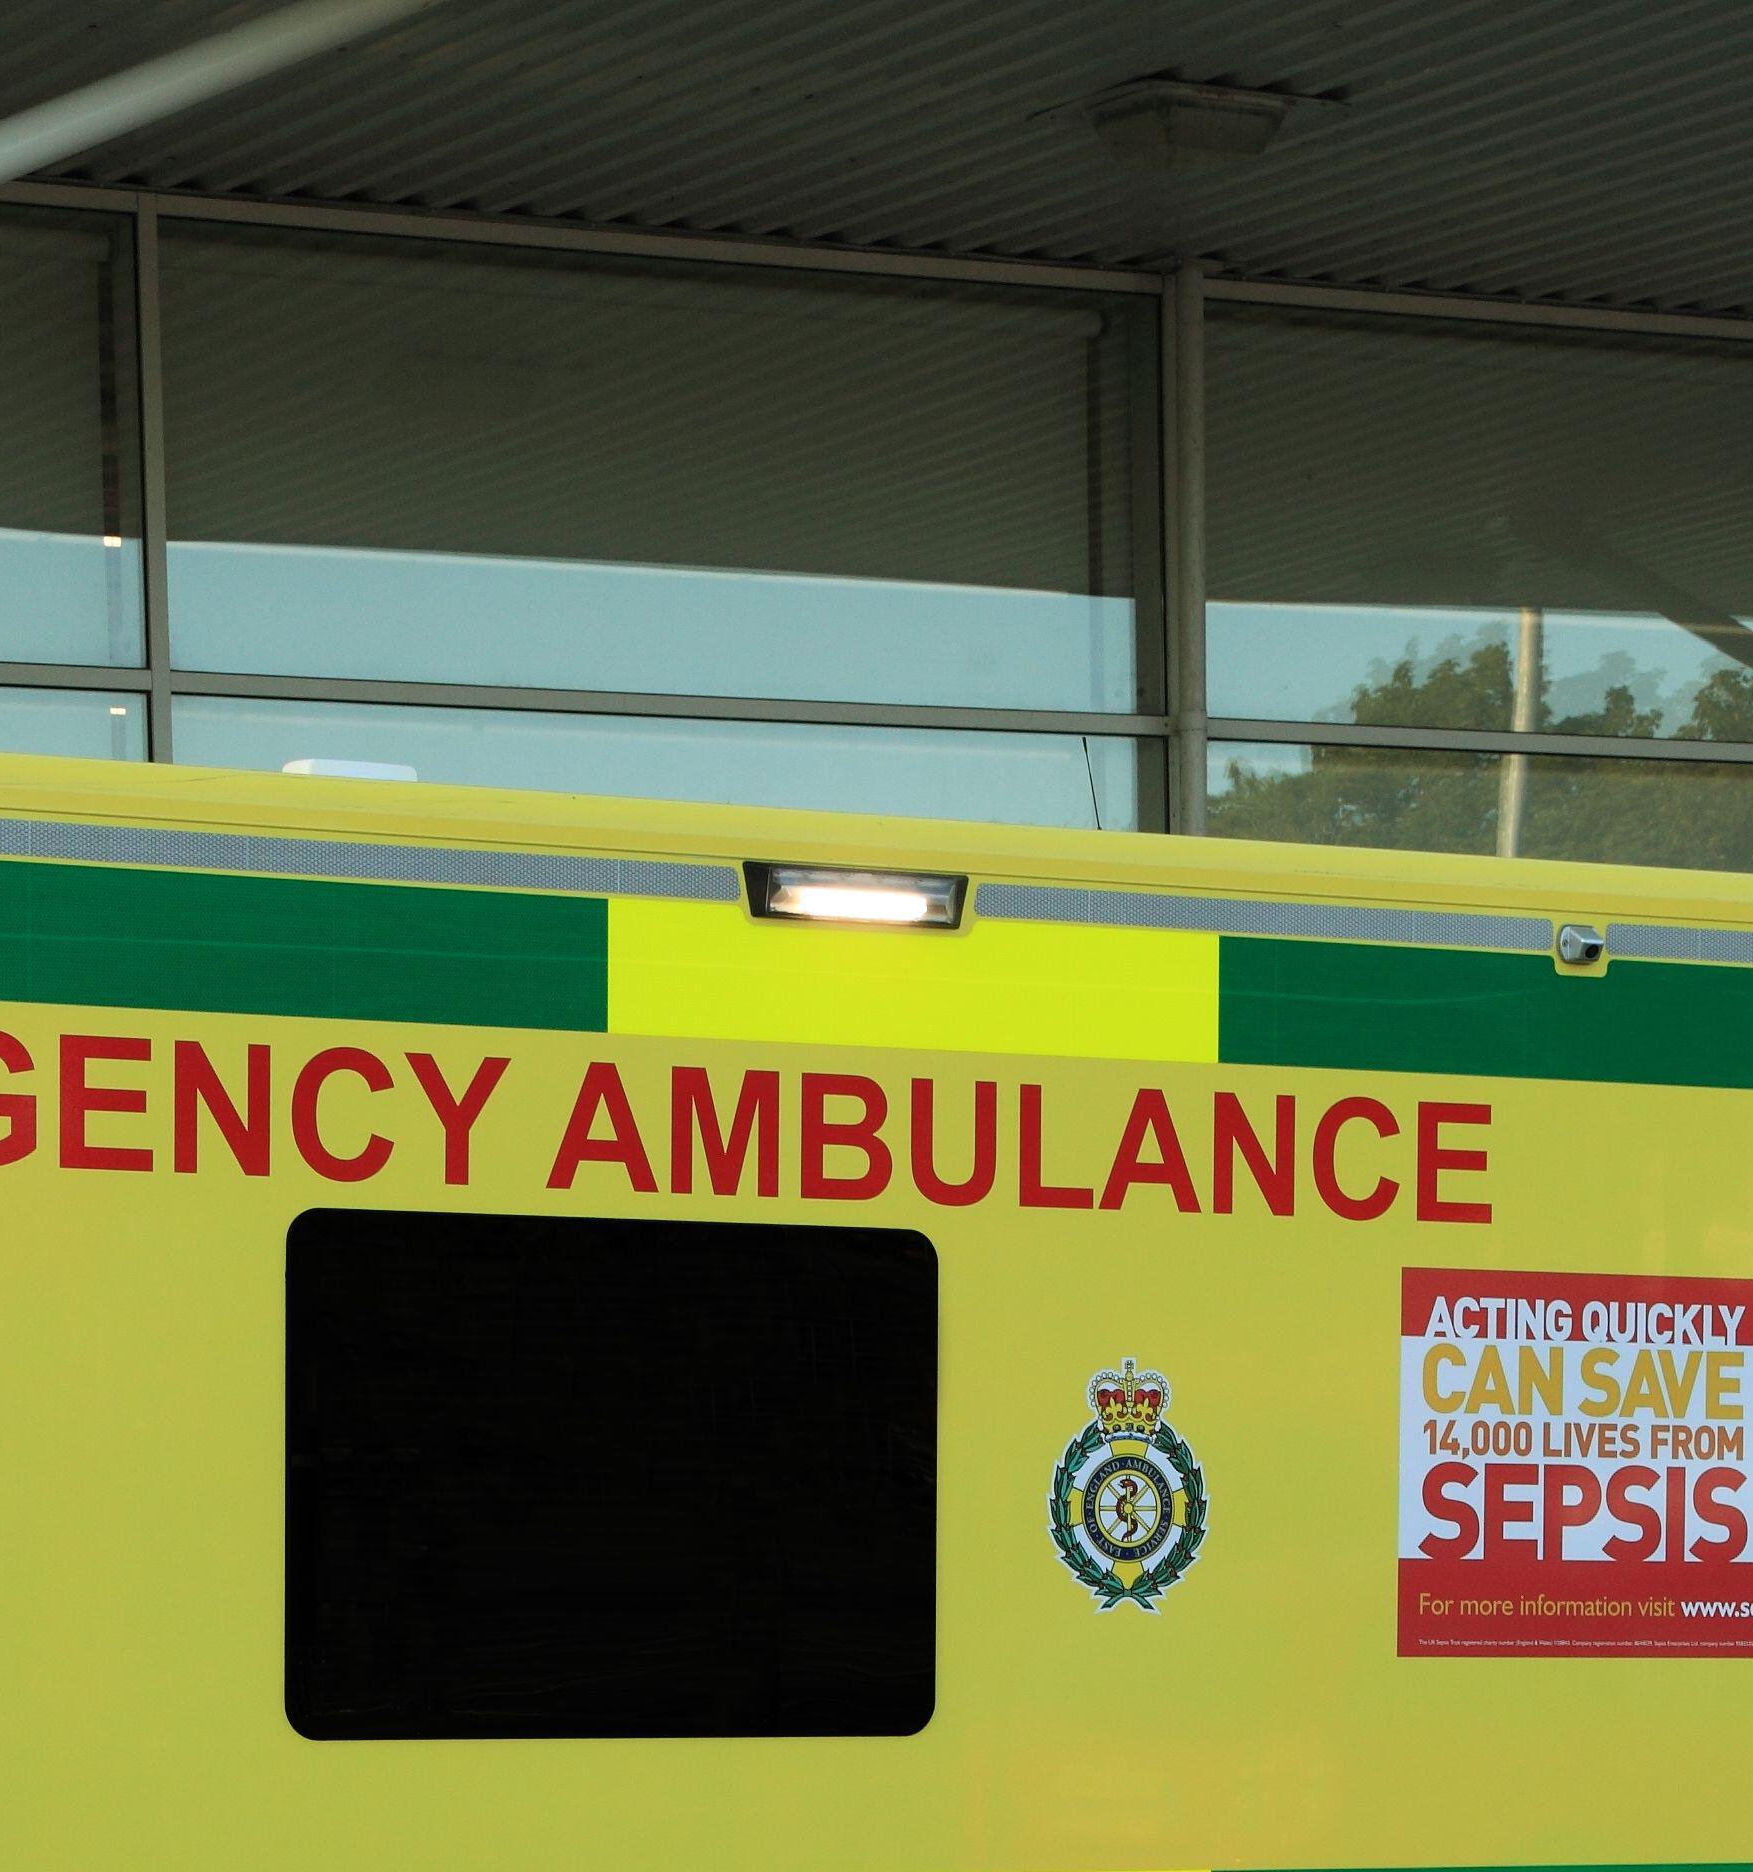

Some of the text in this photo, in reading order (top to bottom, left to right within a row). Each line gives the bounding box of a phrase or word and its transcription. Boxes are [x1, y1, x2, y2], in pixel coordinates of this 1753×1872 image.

[544, 1060, 1495, 1226] AMBULANCE
[1423, 1295, 1746, 1346] ACTING QUICKLY
[1422, 1343, 1744, 1420] CAN SAVE
[1423, 1419, 1743, 1461] 14,000 LIVES FROM
[1085, 1461, 1120, 1507] ENGLAND
[1125, 1457, 1172, 1515] AMBULANCE
[1418, 1461, 1748, 1561] SEPSIS
[1134, 1520, 1169, 1558] SERVICE
[1419, 1592, 1454, 1616] For
[1459, 1598, 1513, 1616] more
[1520, 1595, 1634, 1618] information
[1638, 1597, 1676, 1618] visit
